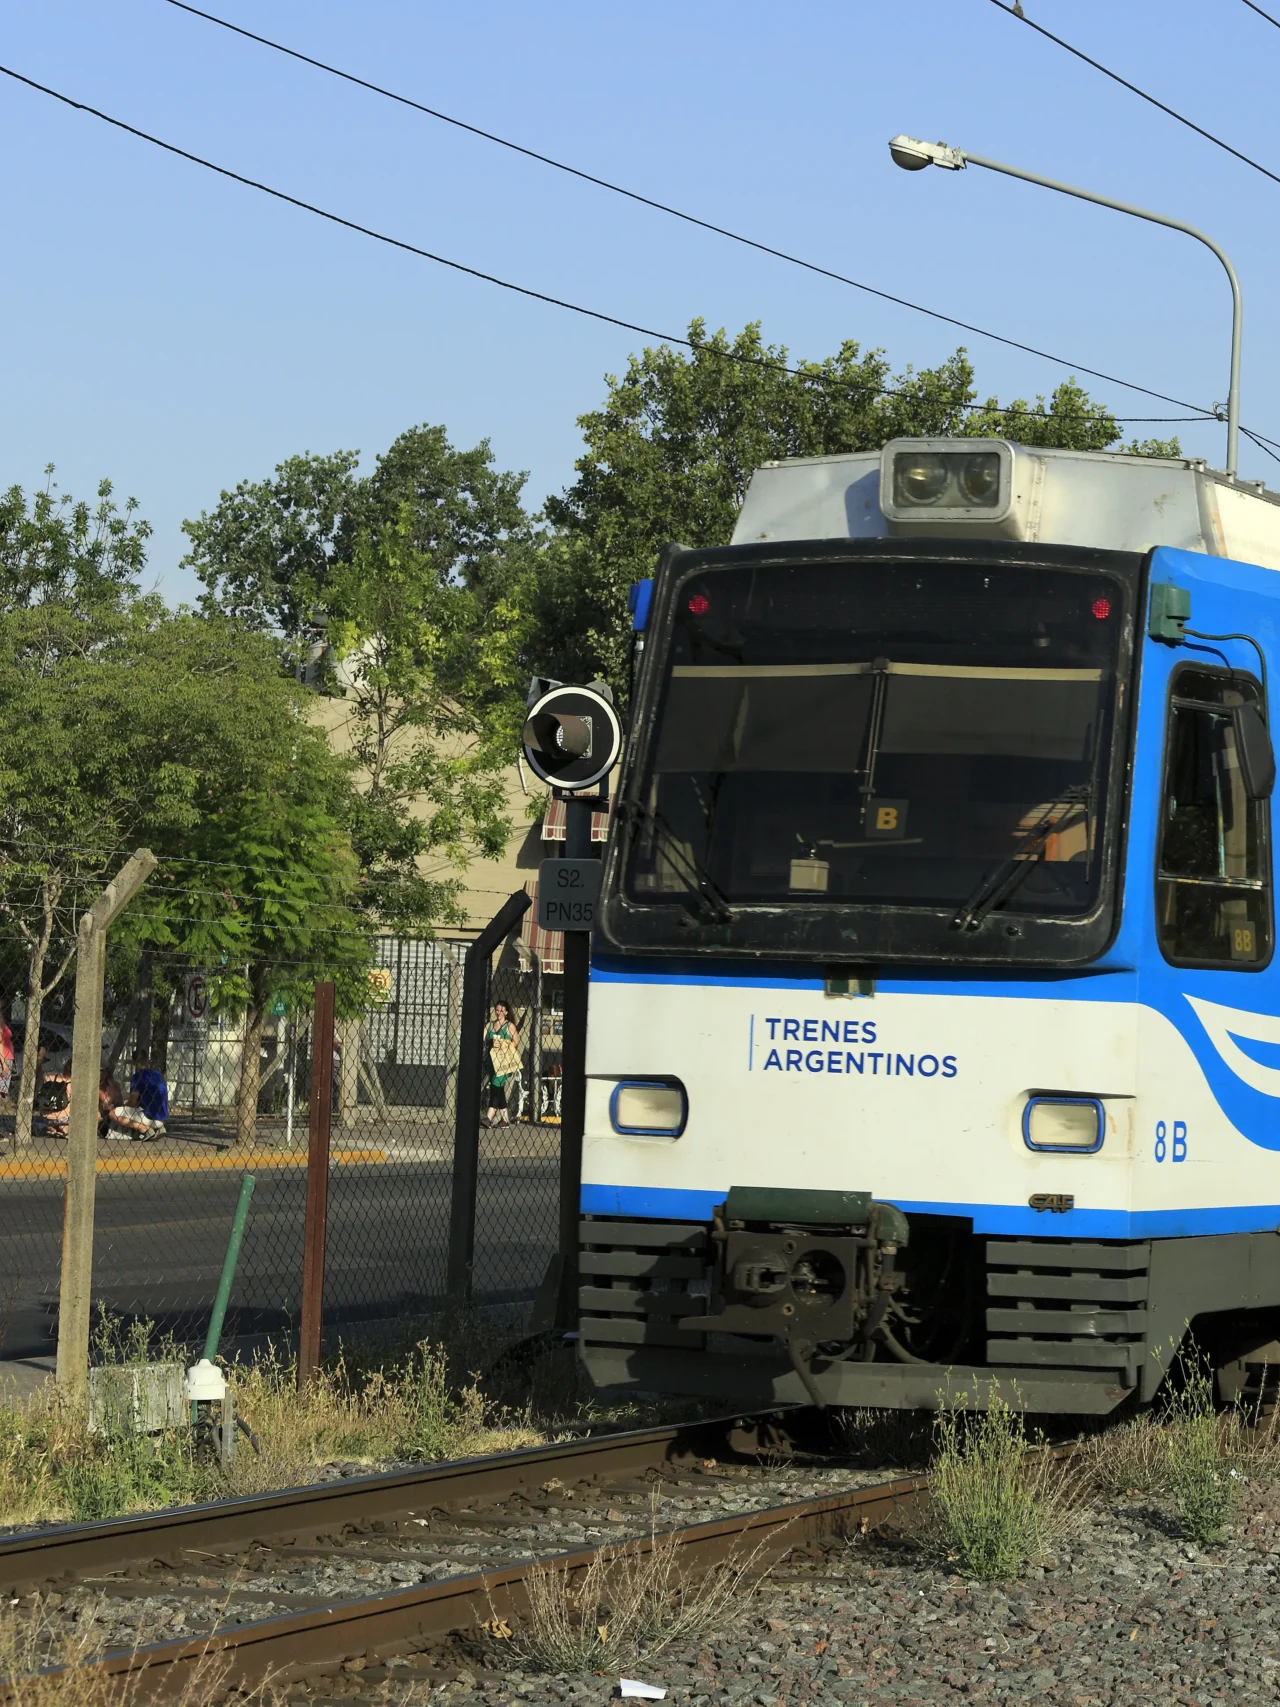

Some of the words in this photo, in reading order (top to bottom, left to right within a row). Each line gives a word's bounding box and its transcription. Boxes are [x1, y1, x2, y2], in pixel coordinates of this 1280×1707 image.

[876, 807, 898, 830] B
[546, 901, 594, 922] PN35
[1234, 929, 1252, 952] 8B
[765, 1018, 877, 1044] TRENES
[763, 1049, 958, 1078] ARGENTINOS
[1028, 1193, 1075, 1213] CAF
